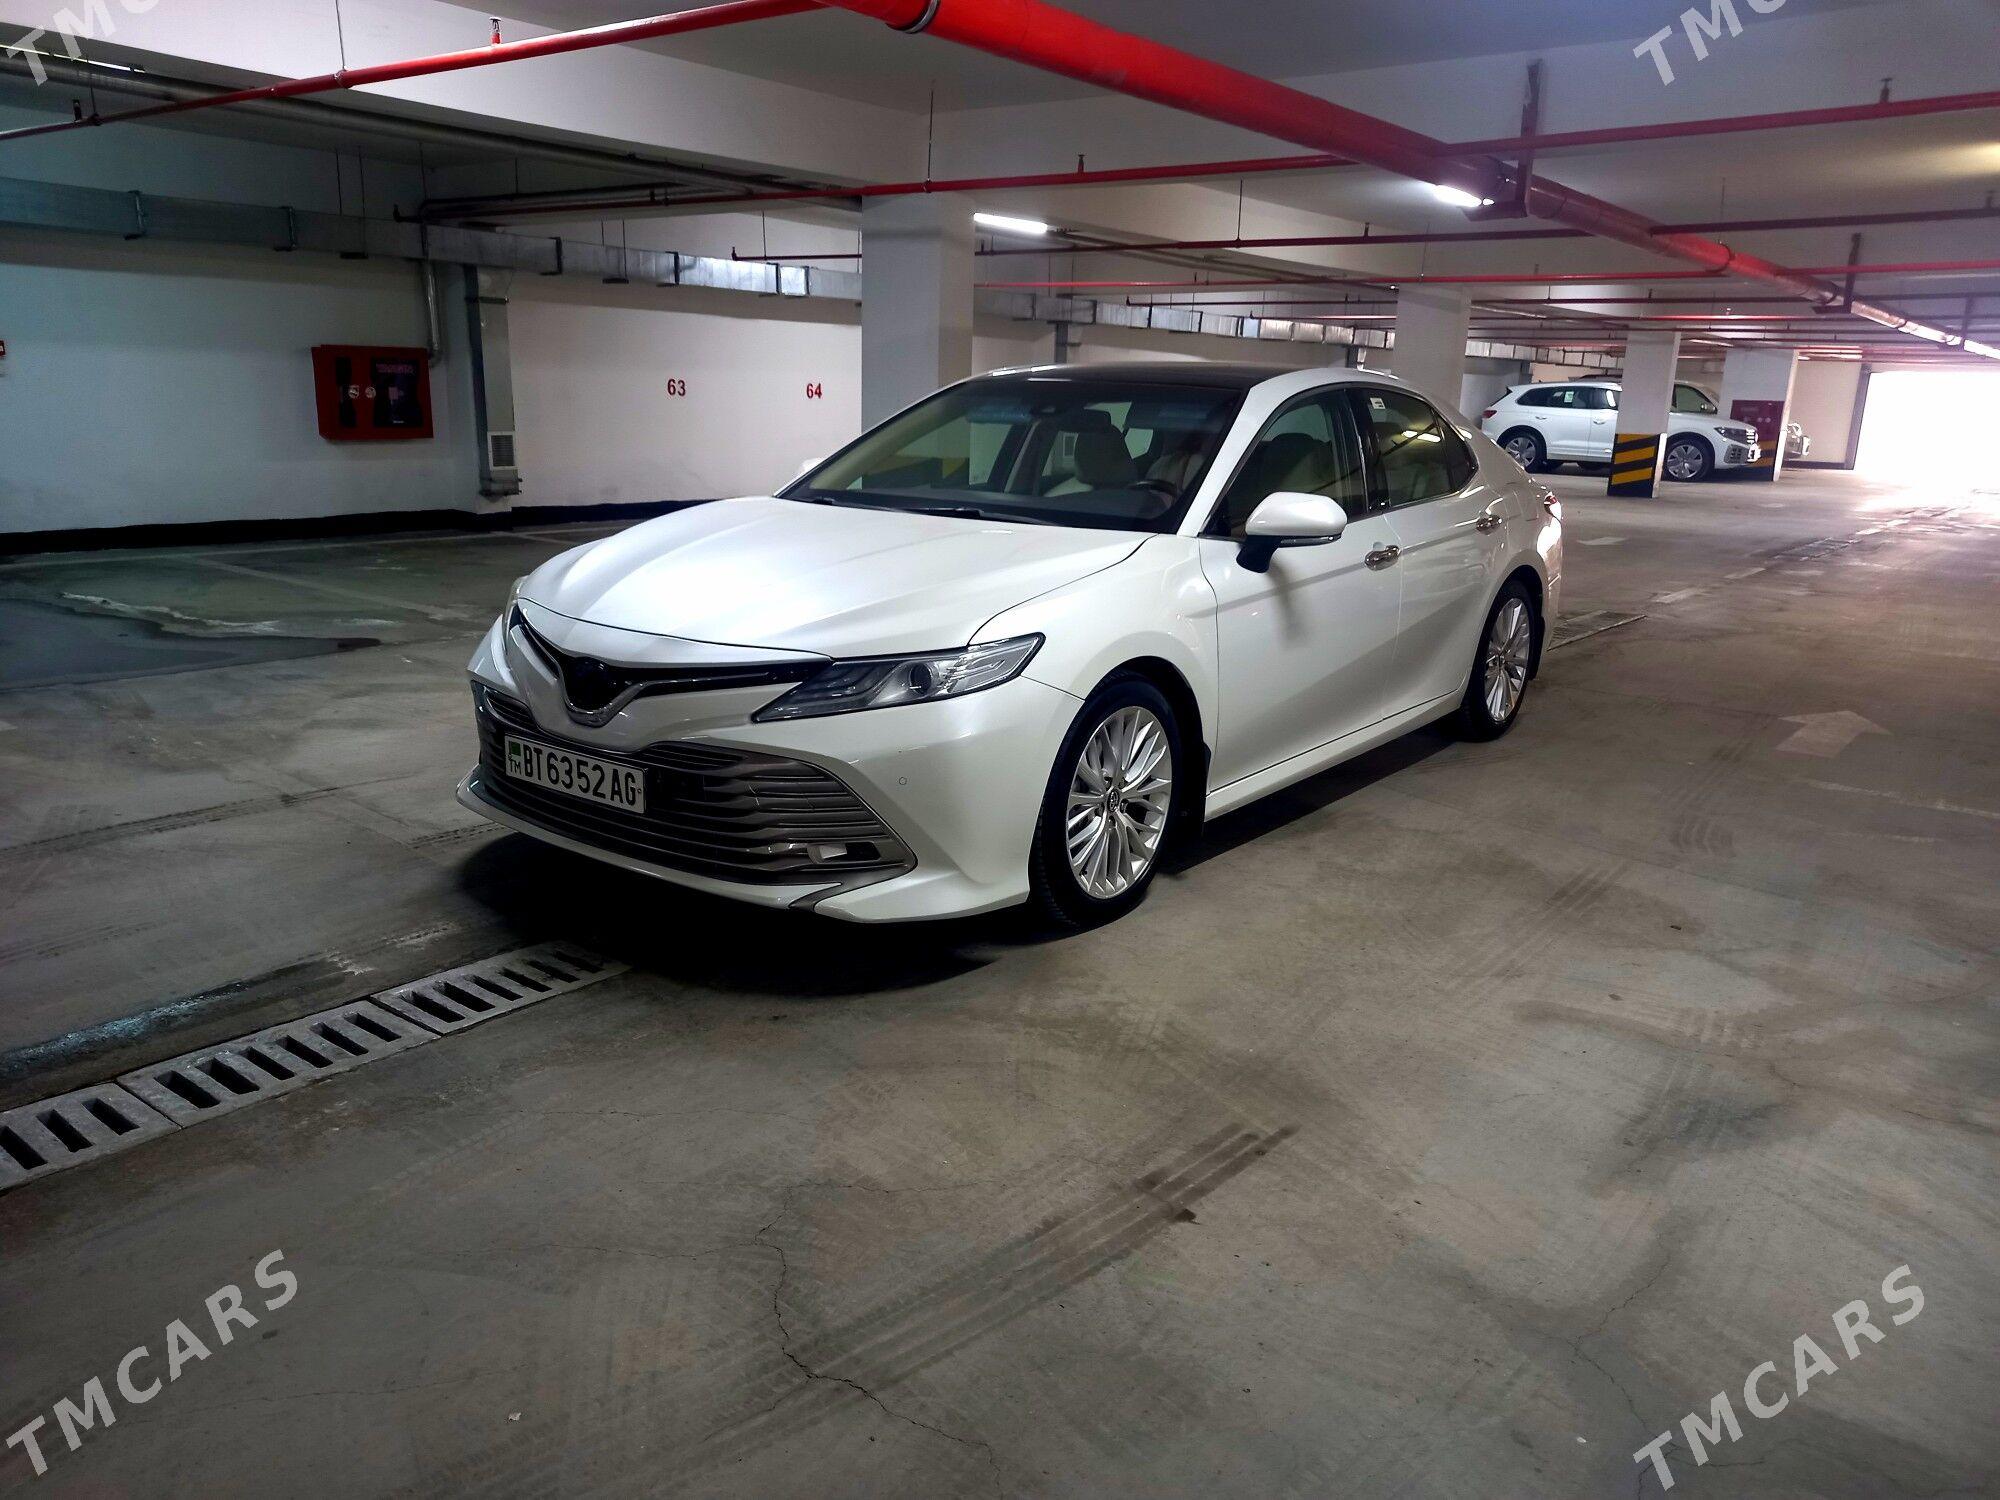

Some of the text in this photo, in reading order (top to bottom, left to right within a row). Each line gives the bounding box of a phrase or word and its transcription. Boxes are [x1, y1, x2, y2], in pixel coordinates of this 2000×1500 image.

[667, 378, 686, 397] 63
[806, 382, 823, 399] 64
[510, 758, 522, 775] TM
